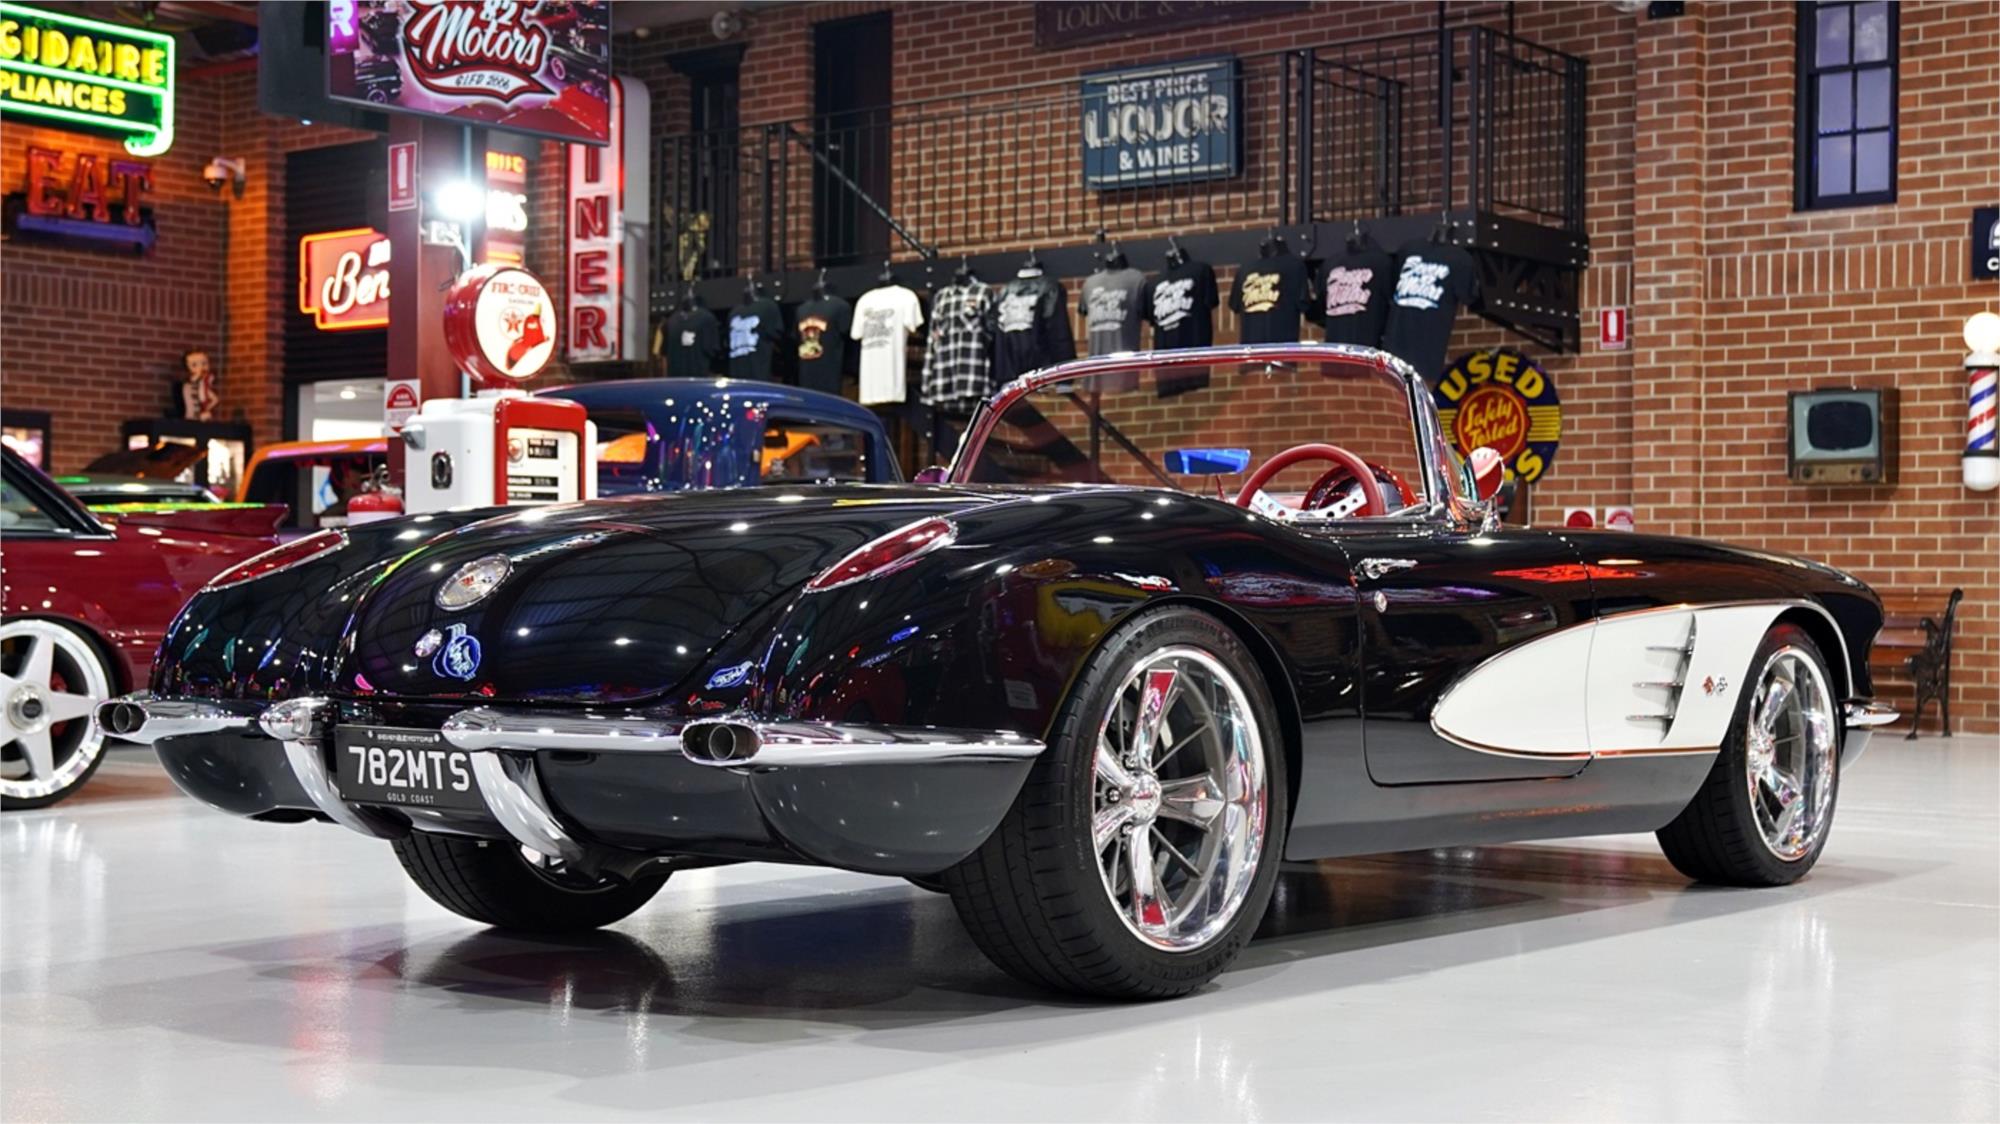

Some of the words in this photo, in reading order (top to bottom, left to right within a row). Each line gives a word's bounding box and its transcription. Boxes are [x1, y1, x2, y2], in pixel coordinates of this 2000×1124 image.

[411, 4, 542, 66] Motors
[1056, 0, 1147, 33] LOUNGE
[1107, 81, 1150, 105] BEST
[1154, 73, 1208, 98] PRICE
[1085, 94, 1228, 149] LIQUOR
[1119, 151, 1133, 171] &
[1137, 143, 1200, 168] WINES
[26, 148, 149, 225] EAT
[573, 145, 609, 350] INER
[1440, 351, 1544, 401] USED
[1464, 397, 1513, 433] Safety
[1468, 415, 1518, 449] Tested
[348, 745, 470, 791] 782MTS
[386, 792, 406, 802] GOLD
[410, 794, 434, 804] COAST
